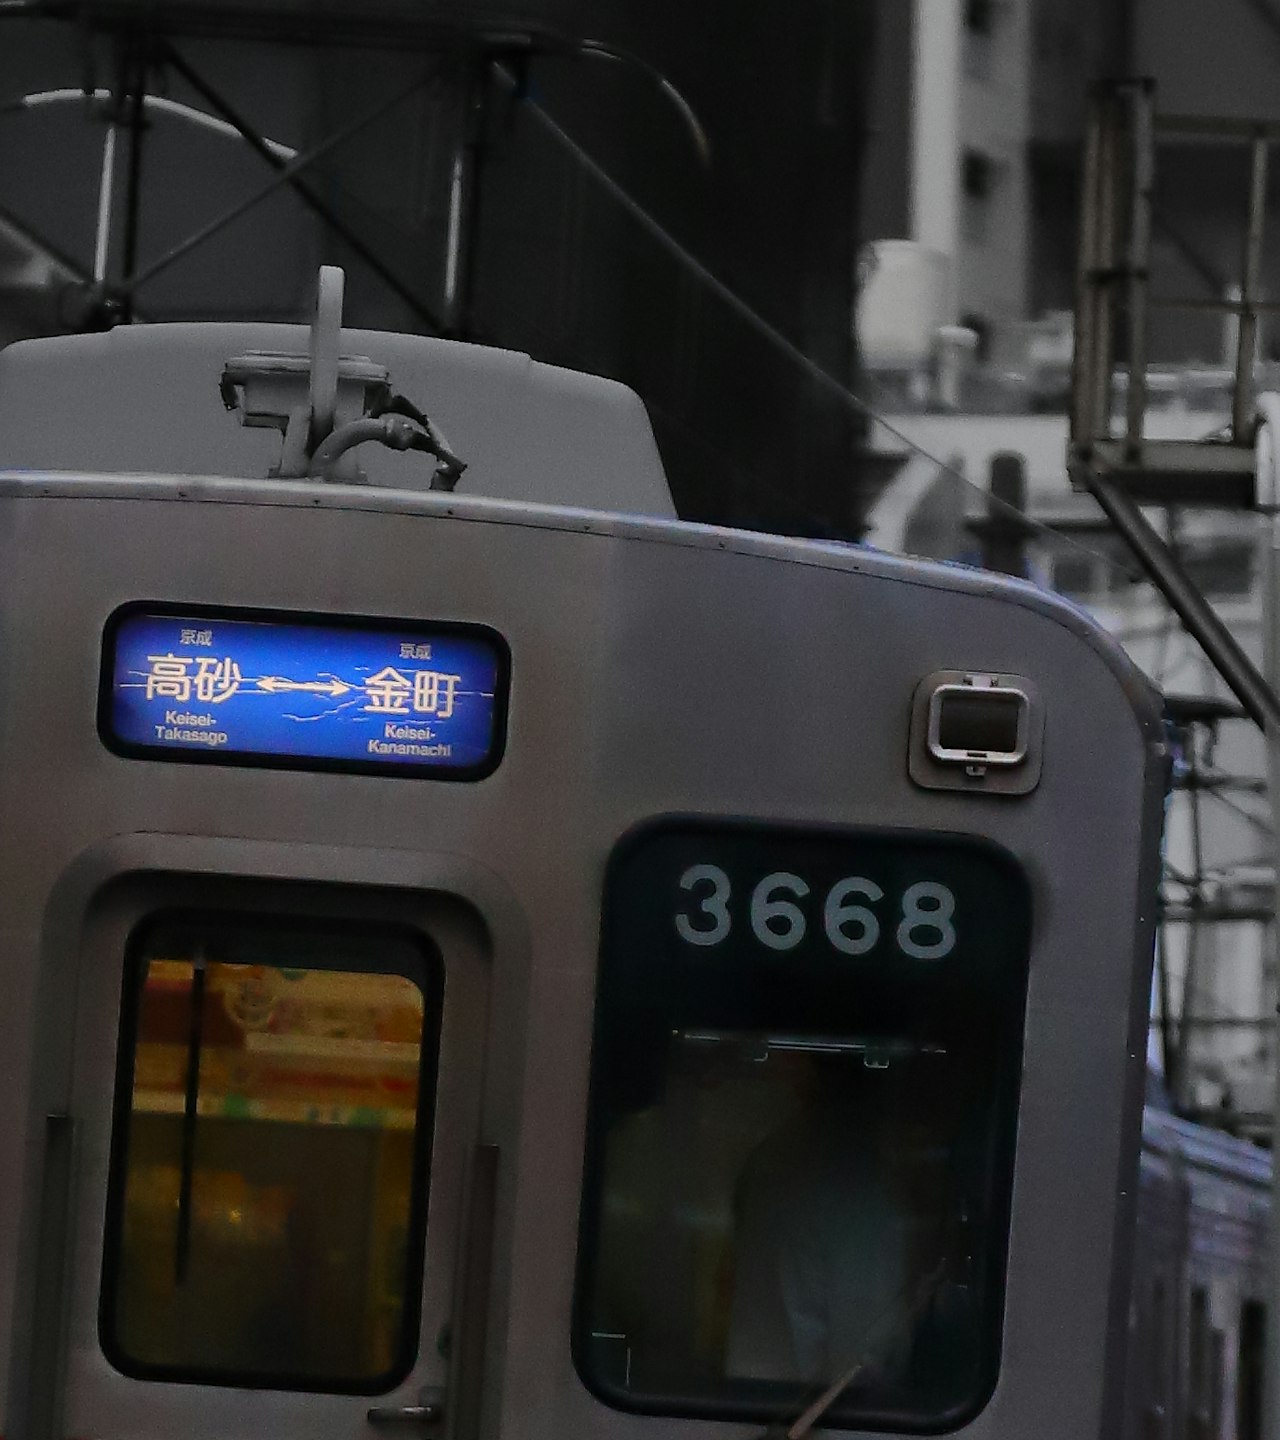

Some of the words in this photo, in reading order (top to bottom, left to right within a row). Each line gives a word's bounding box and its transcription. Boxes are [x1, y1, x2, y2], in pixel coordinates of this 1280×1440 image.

[179, 629, 212, 646] 京成
[398, 642, 431, 660] 京成
[146, 653, 242, 705] 高砂
[363, 666, 462, 718] 金町
[165, 711, 216, 727] Keisei-
[155, 726, 228, 746] Takasago
[384, 723, 436, 741] Keisei-
[368, 739, 451, 757] Kanamachi
[675, 863, 957, 959] 3668
